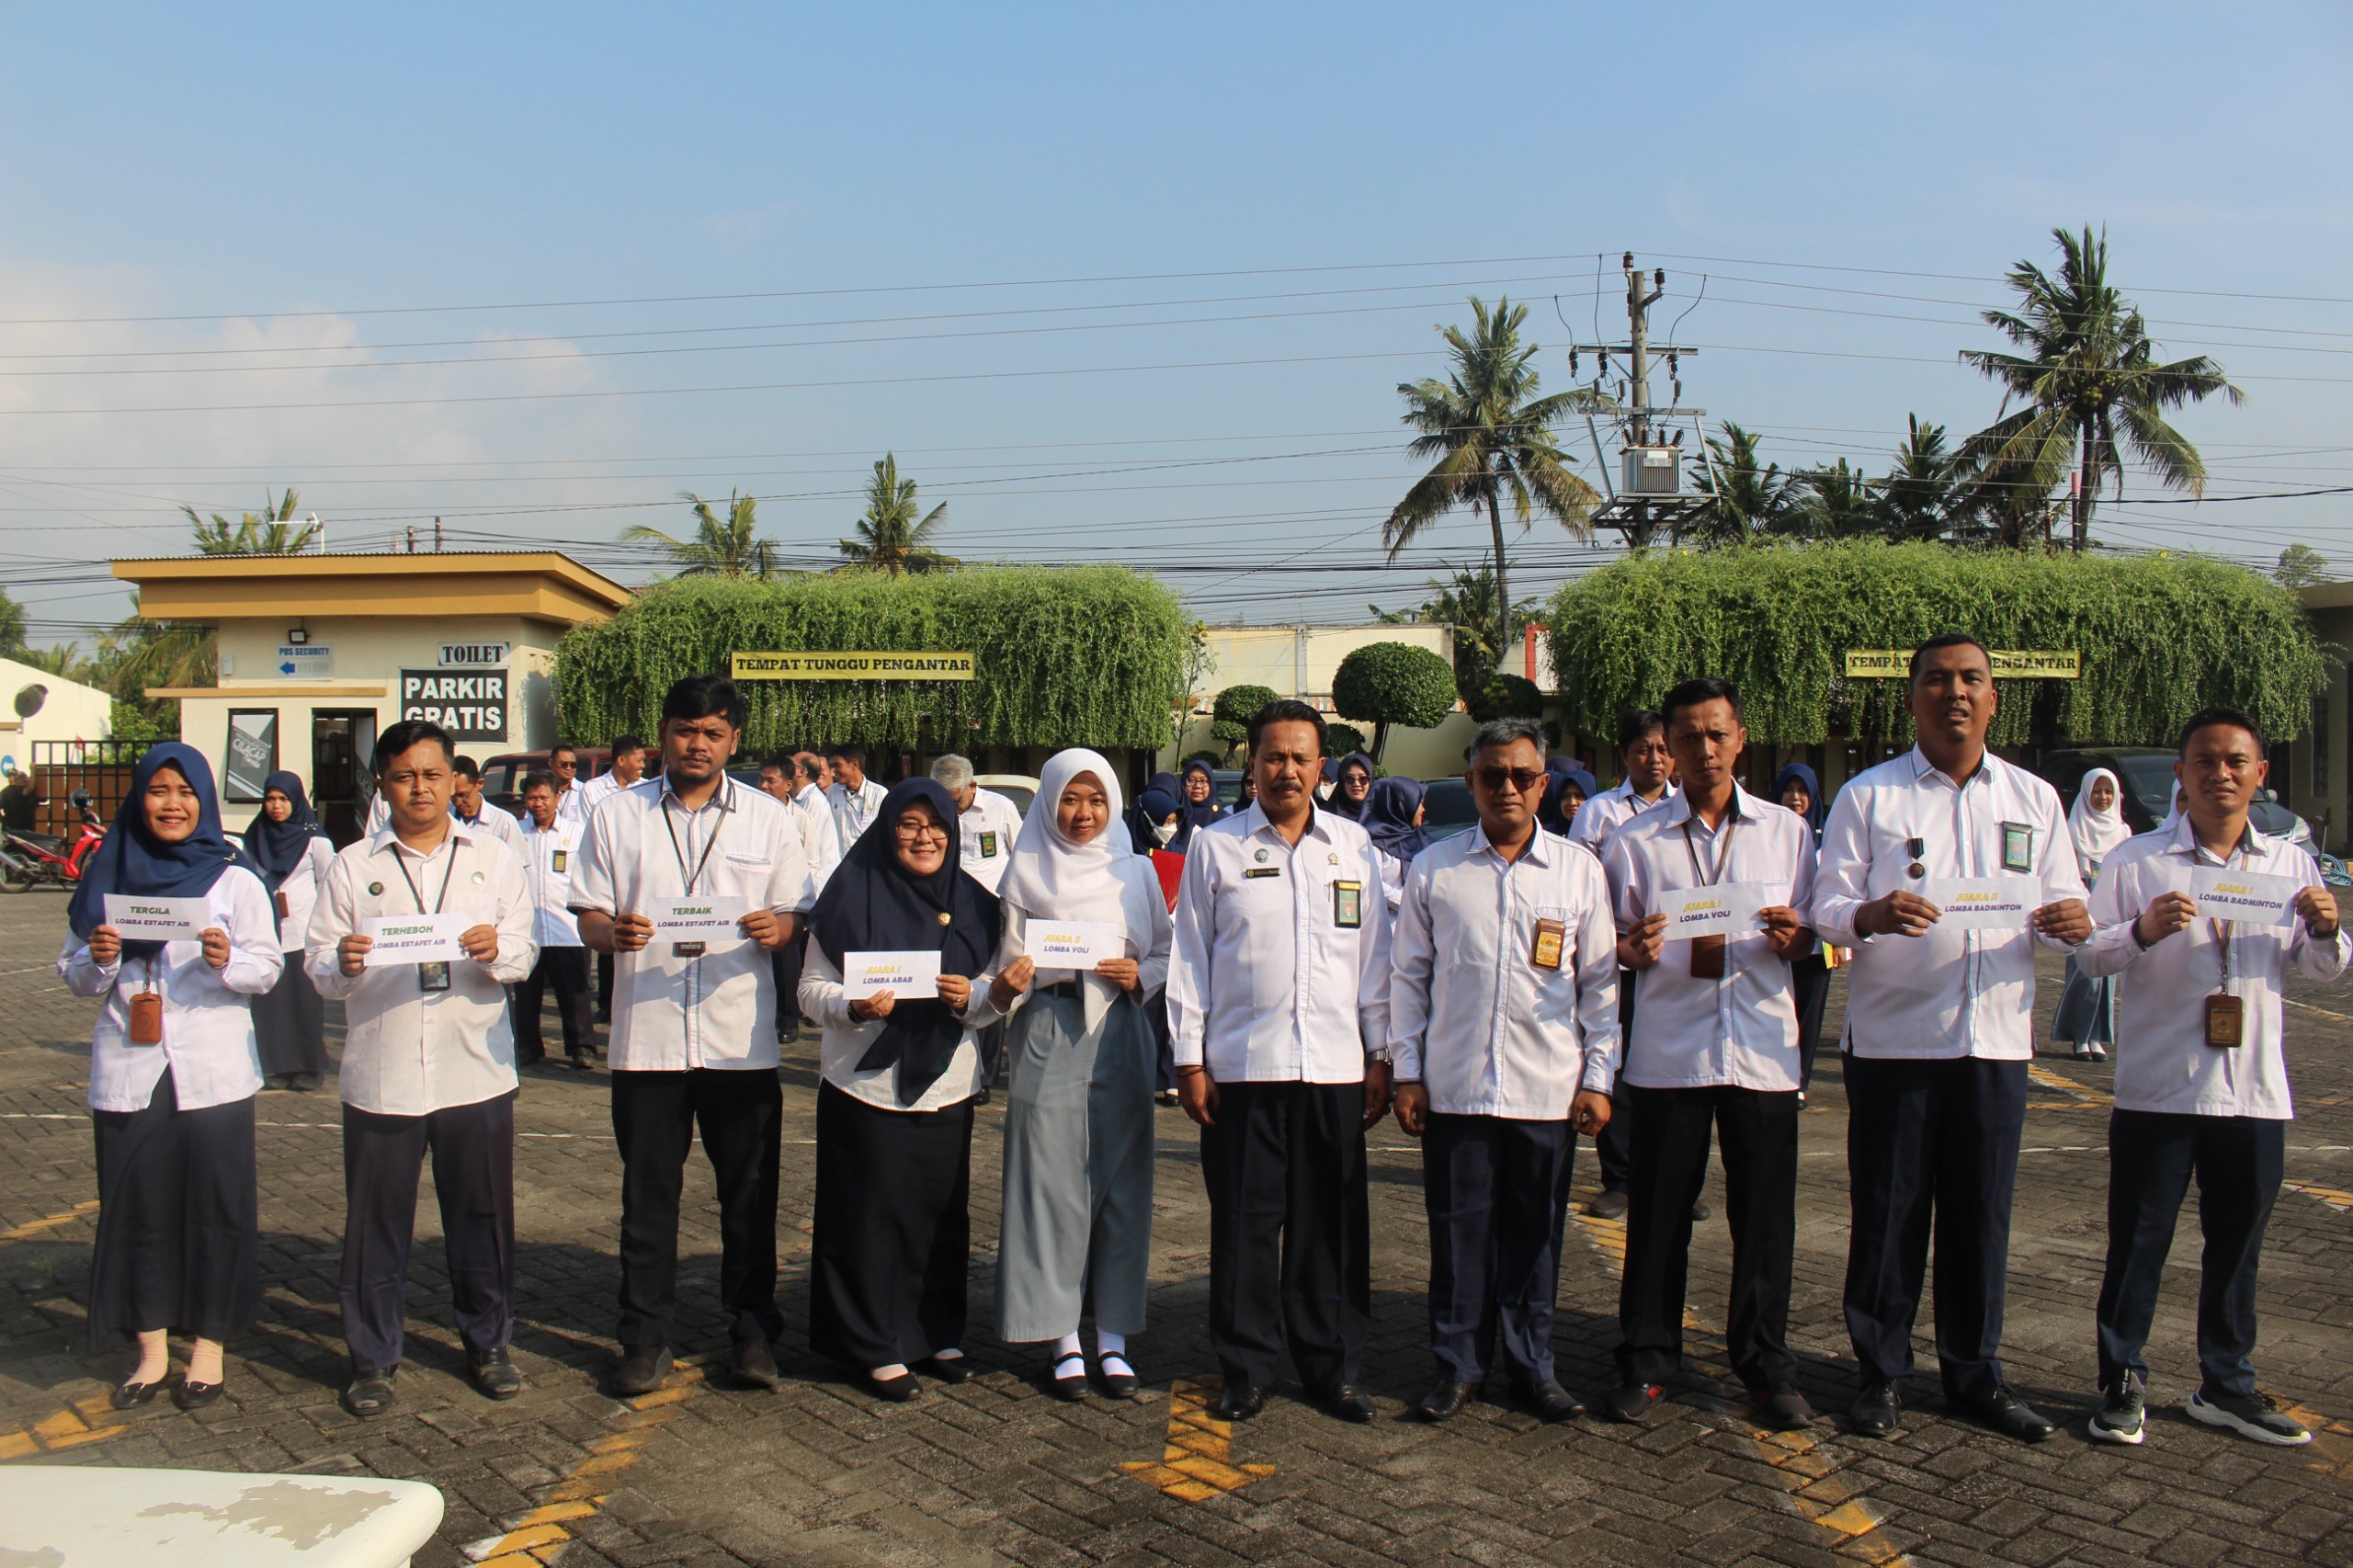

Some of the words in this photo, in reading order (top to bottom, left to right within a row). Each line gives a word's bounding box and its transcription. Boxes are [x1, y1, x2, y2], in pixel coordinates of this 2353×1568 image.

[443, 646, 503, 663] TOILET
[736, 659, 801, 670] TEMPAT
[804, 659, 869, 671] TUNGGU
[872, 659, 971, 671] PENGANTAR
[1992, 658, 2076, 669] ENGANTAR
[405, 677, 503, 699] PARKIR
[405, 707, 501, 730] GRATIS
[233, 738, 266, 761] CILACAP
[1955, 893, 1989, 902] JUARA
[2199, 892, 2229, 903] LOMBA
[2230, 896, 2283, 910] BADMINTON
[130, 906, 170, 915] TERGILA
[672, 907, 712, 915] TERBAIK
[1683, 900, 1716, 913] JUARA
[1679, 914, 1710, 923] LOMBA
[1711, 910, 1731, 919] VOLI
[381, 926, 434, 936] TERHEBOH
[1043, 945, 1071, 953] LOMBA
[865, 965, 896, 974] JUARA
